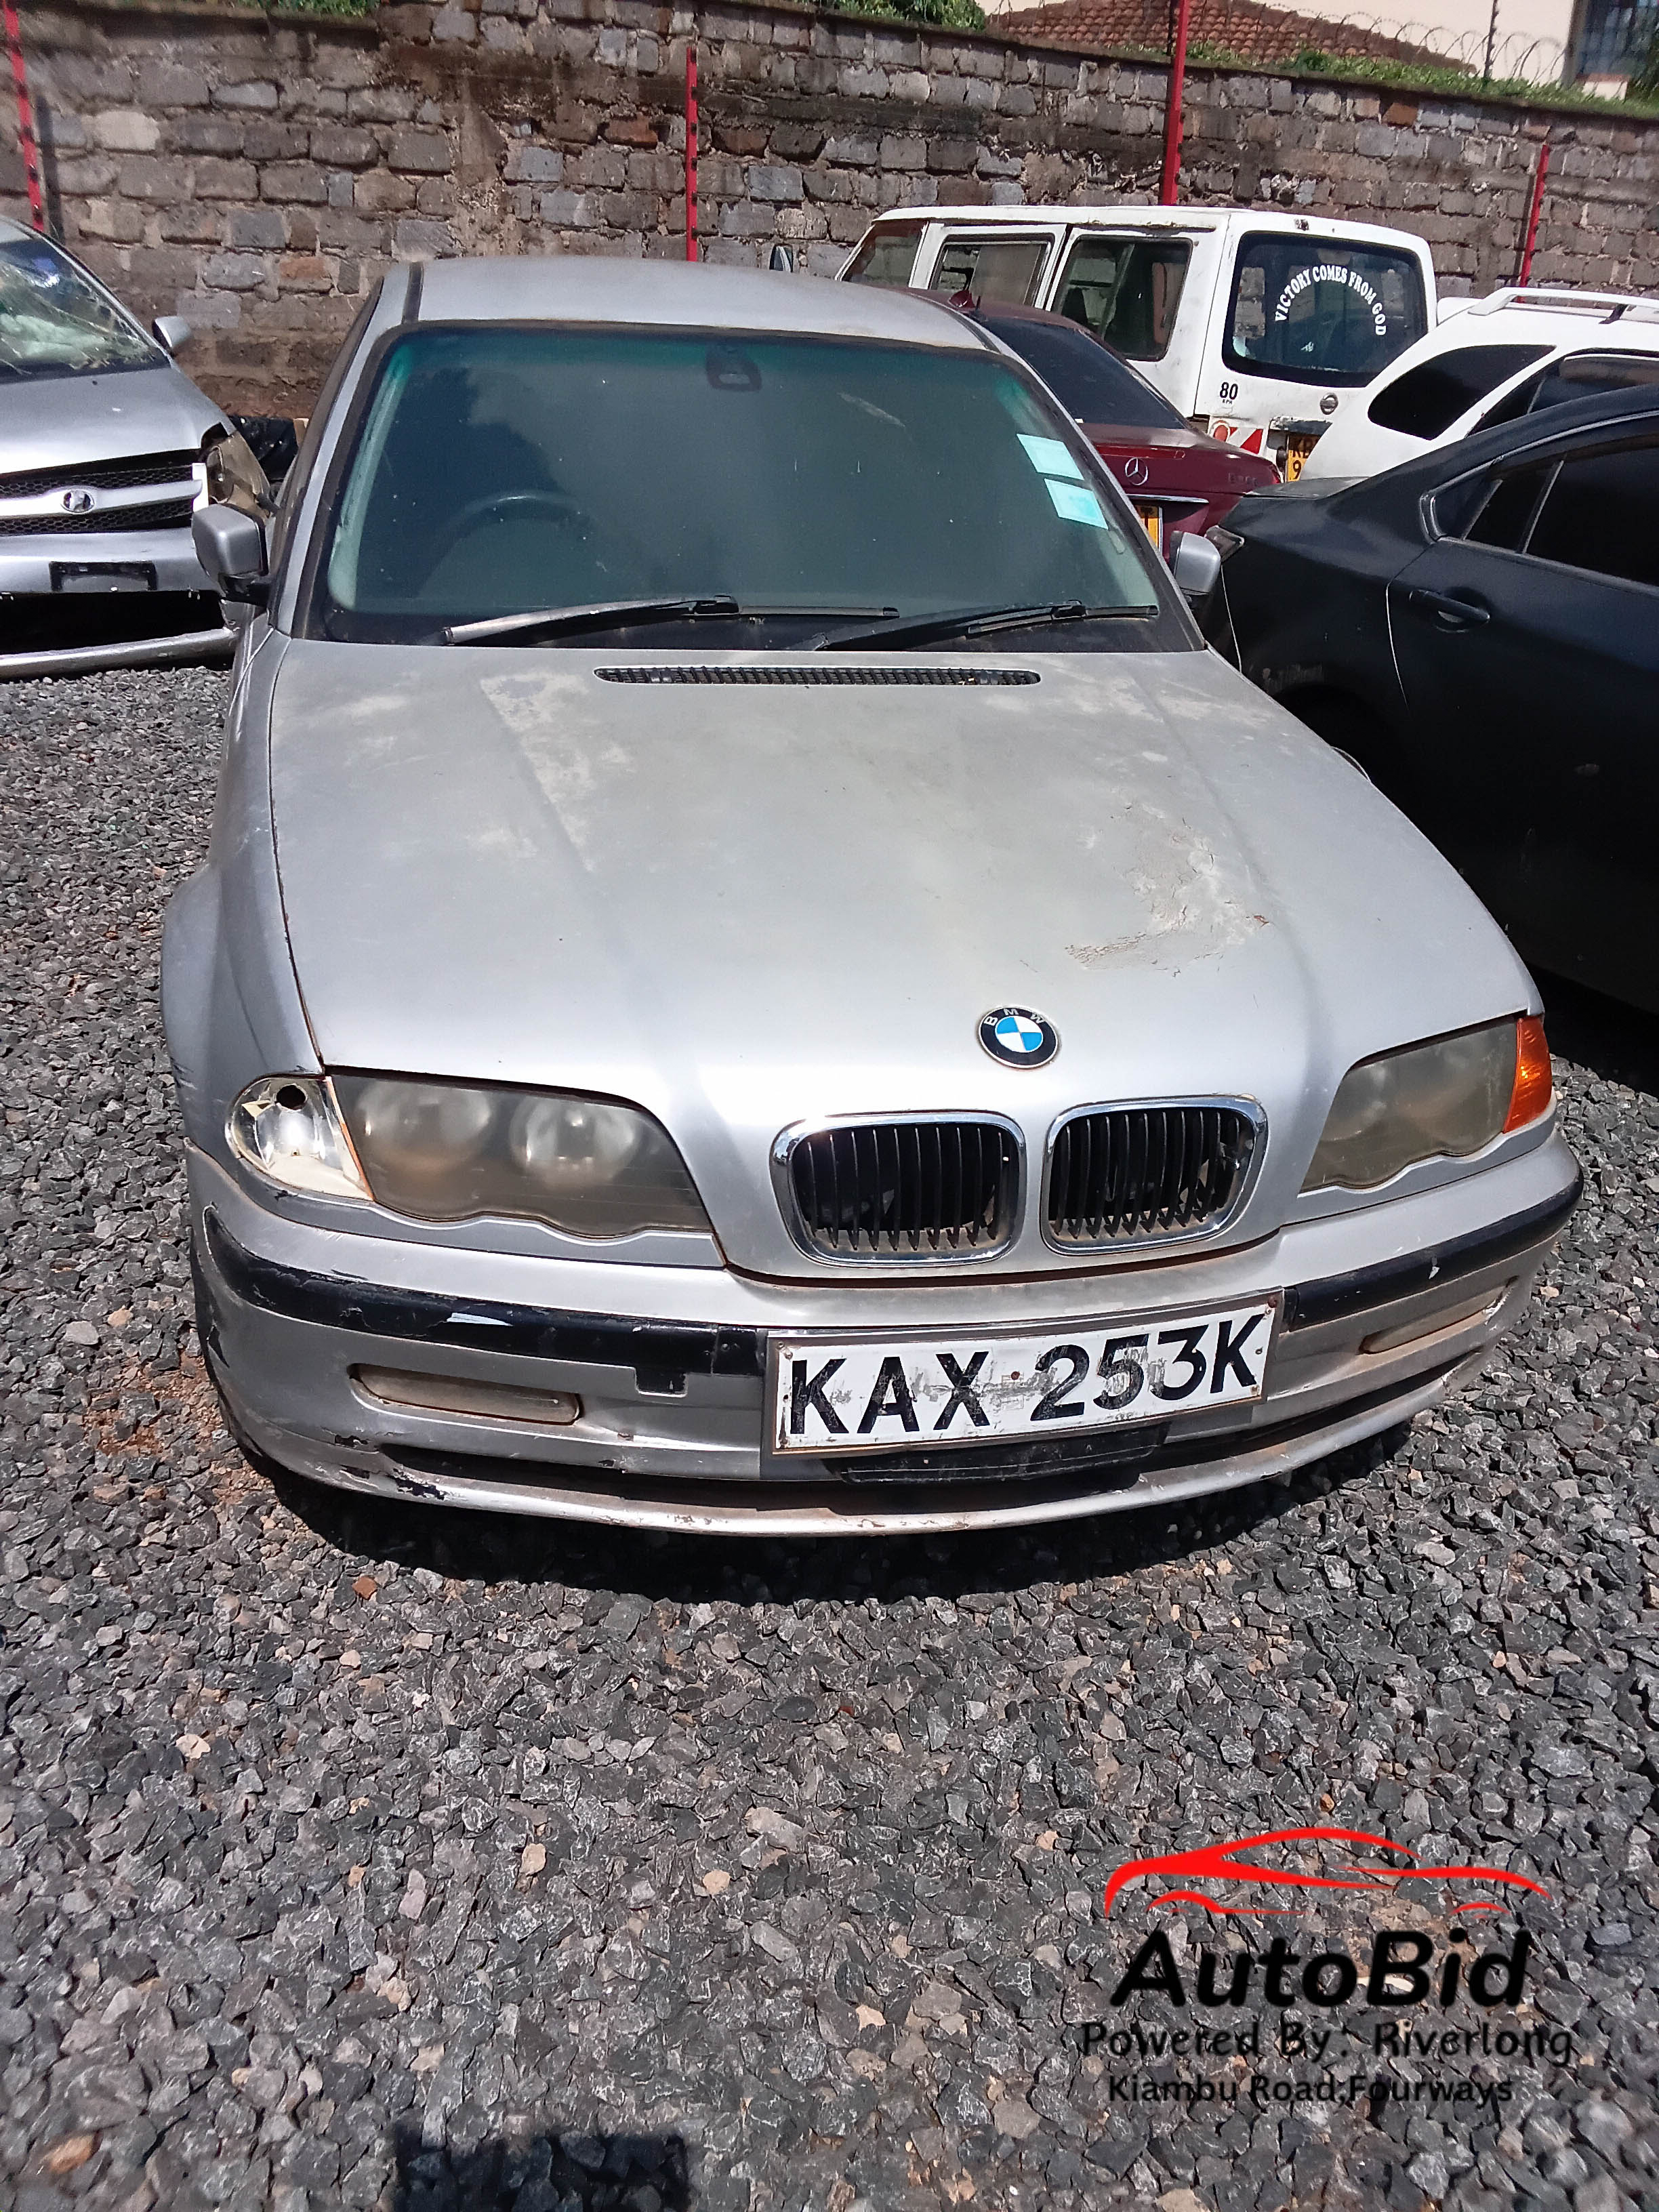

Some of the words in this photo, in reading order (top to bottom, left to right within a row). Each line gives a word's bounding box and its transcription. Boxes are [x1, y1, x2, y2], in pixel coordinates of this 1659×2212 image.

[1275, 269, 1311, 321] VICTORY
[1313, 265, 1348, 283] COMES
[1348, 271, 1376, 304] FROM
[1372, 302, 1387, 335] GOD
[1220, 382, 1238, 400] 80
[1291, 438, 1319, 458] KB
[984, 1008, 1046, 1026] BMW
[790, 1351, 990, 1435] KAX
[1030, 1314, 1264, 1421] 253K
